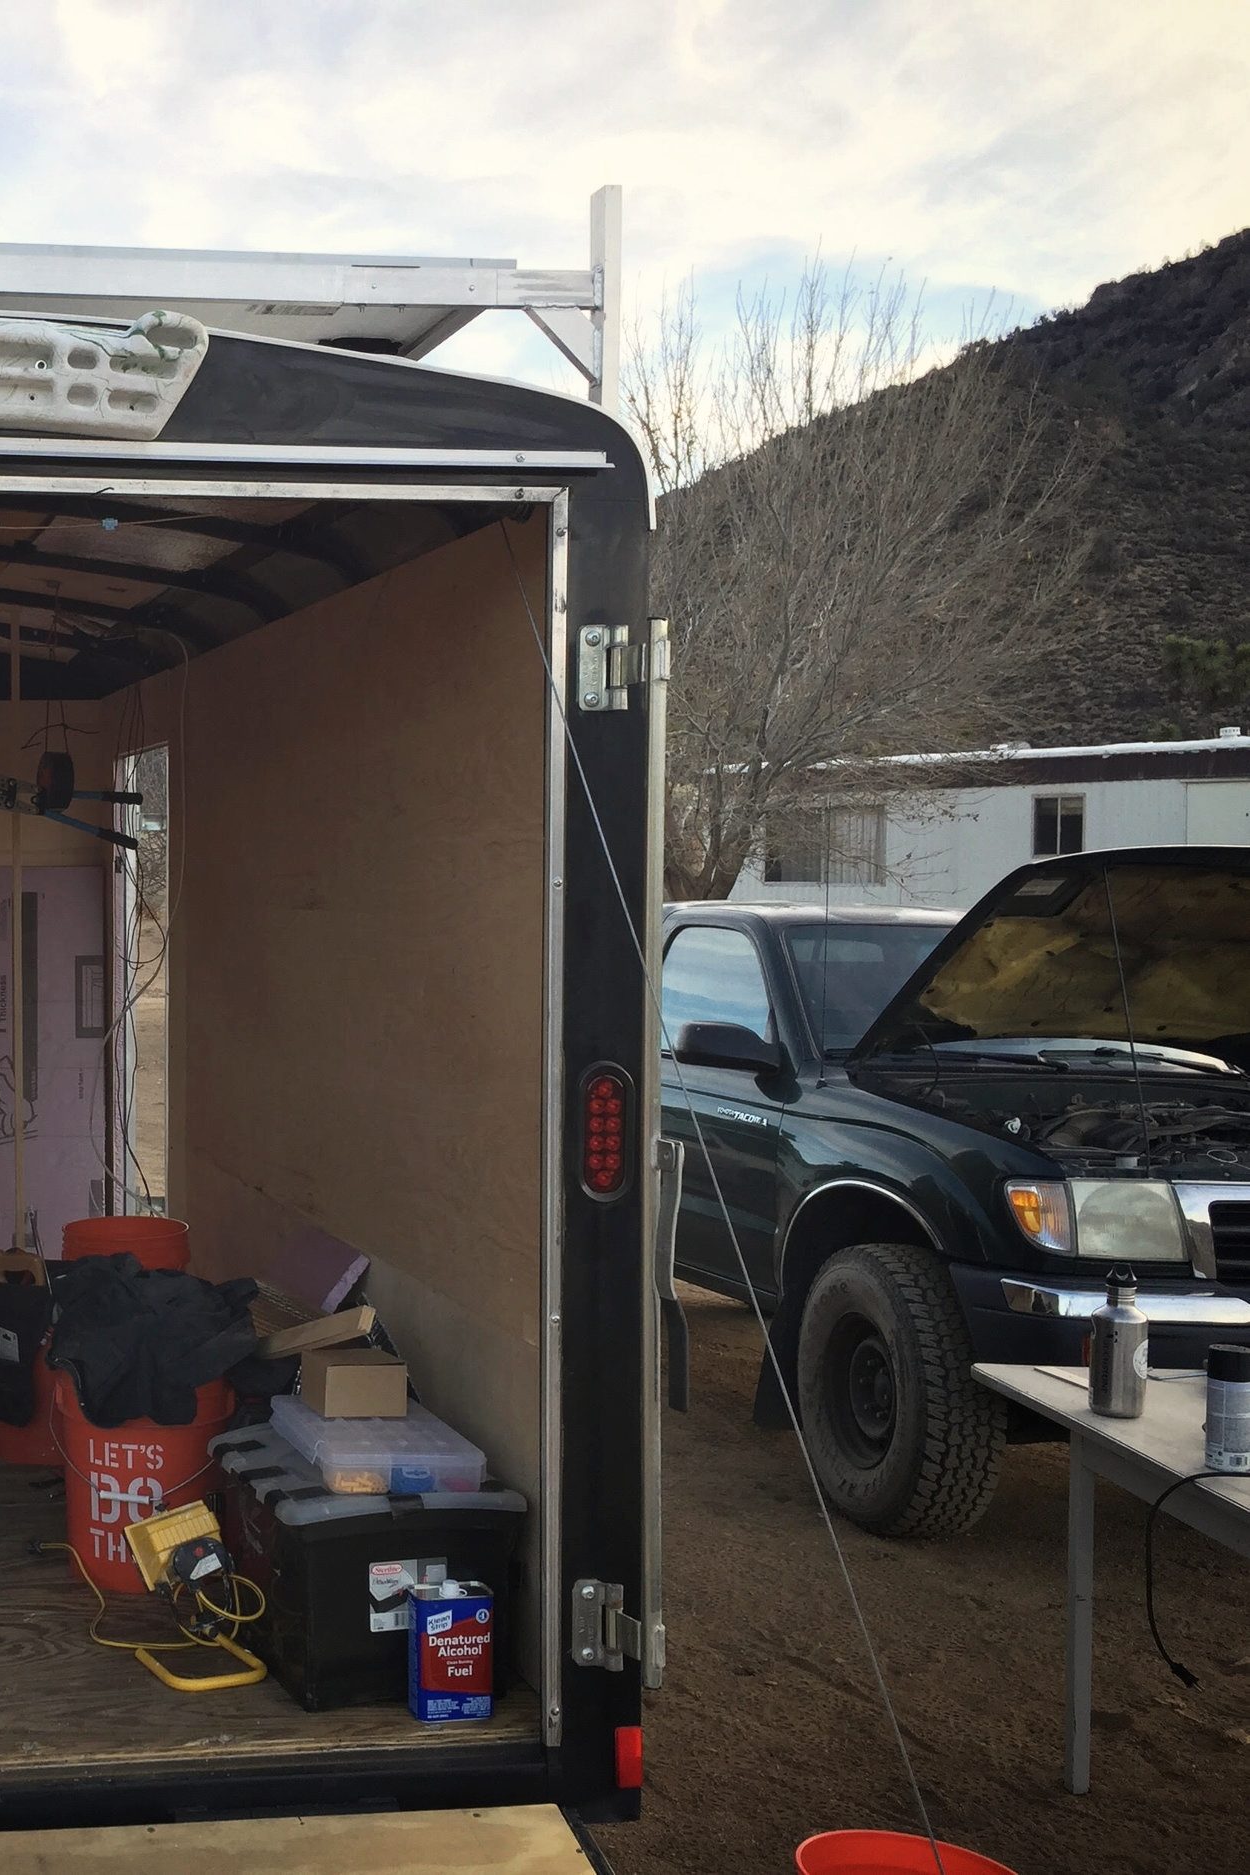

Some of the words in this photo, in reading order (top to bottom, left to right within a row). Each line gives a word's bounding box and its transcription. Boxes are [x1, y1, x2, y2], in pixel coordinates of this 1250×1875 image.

[0, 975, 7, 1023] Thickness
[733, 1111, 768, 1127] TACOMA
[88, 1438, 165, 1471] LET'S
[90, 1471, 163, 1524] DO
[89, 1527, 136, 1563] TH
[429, 1615, 450, 1627] Klean
[430, 1622, 448, 1632] Strip
[428, 1631, 491, 1647] Denatured
[437, 1644, 483, 1658] Alcohol
[448, 1665, 473, 1677] Fuel
